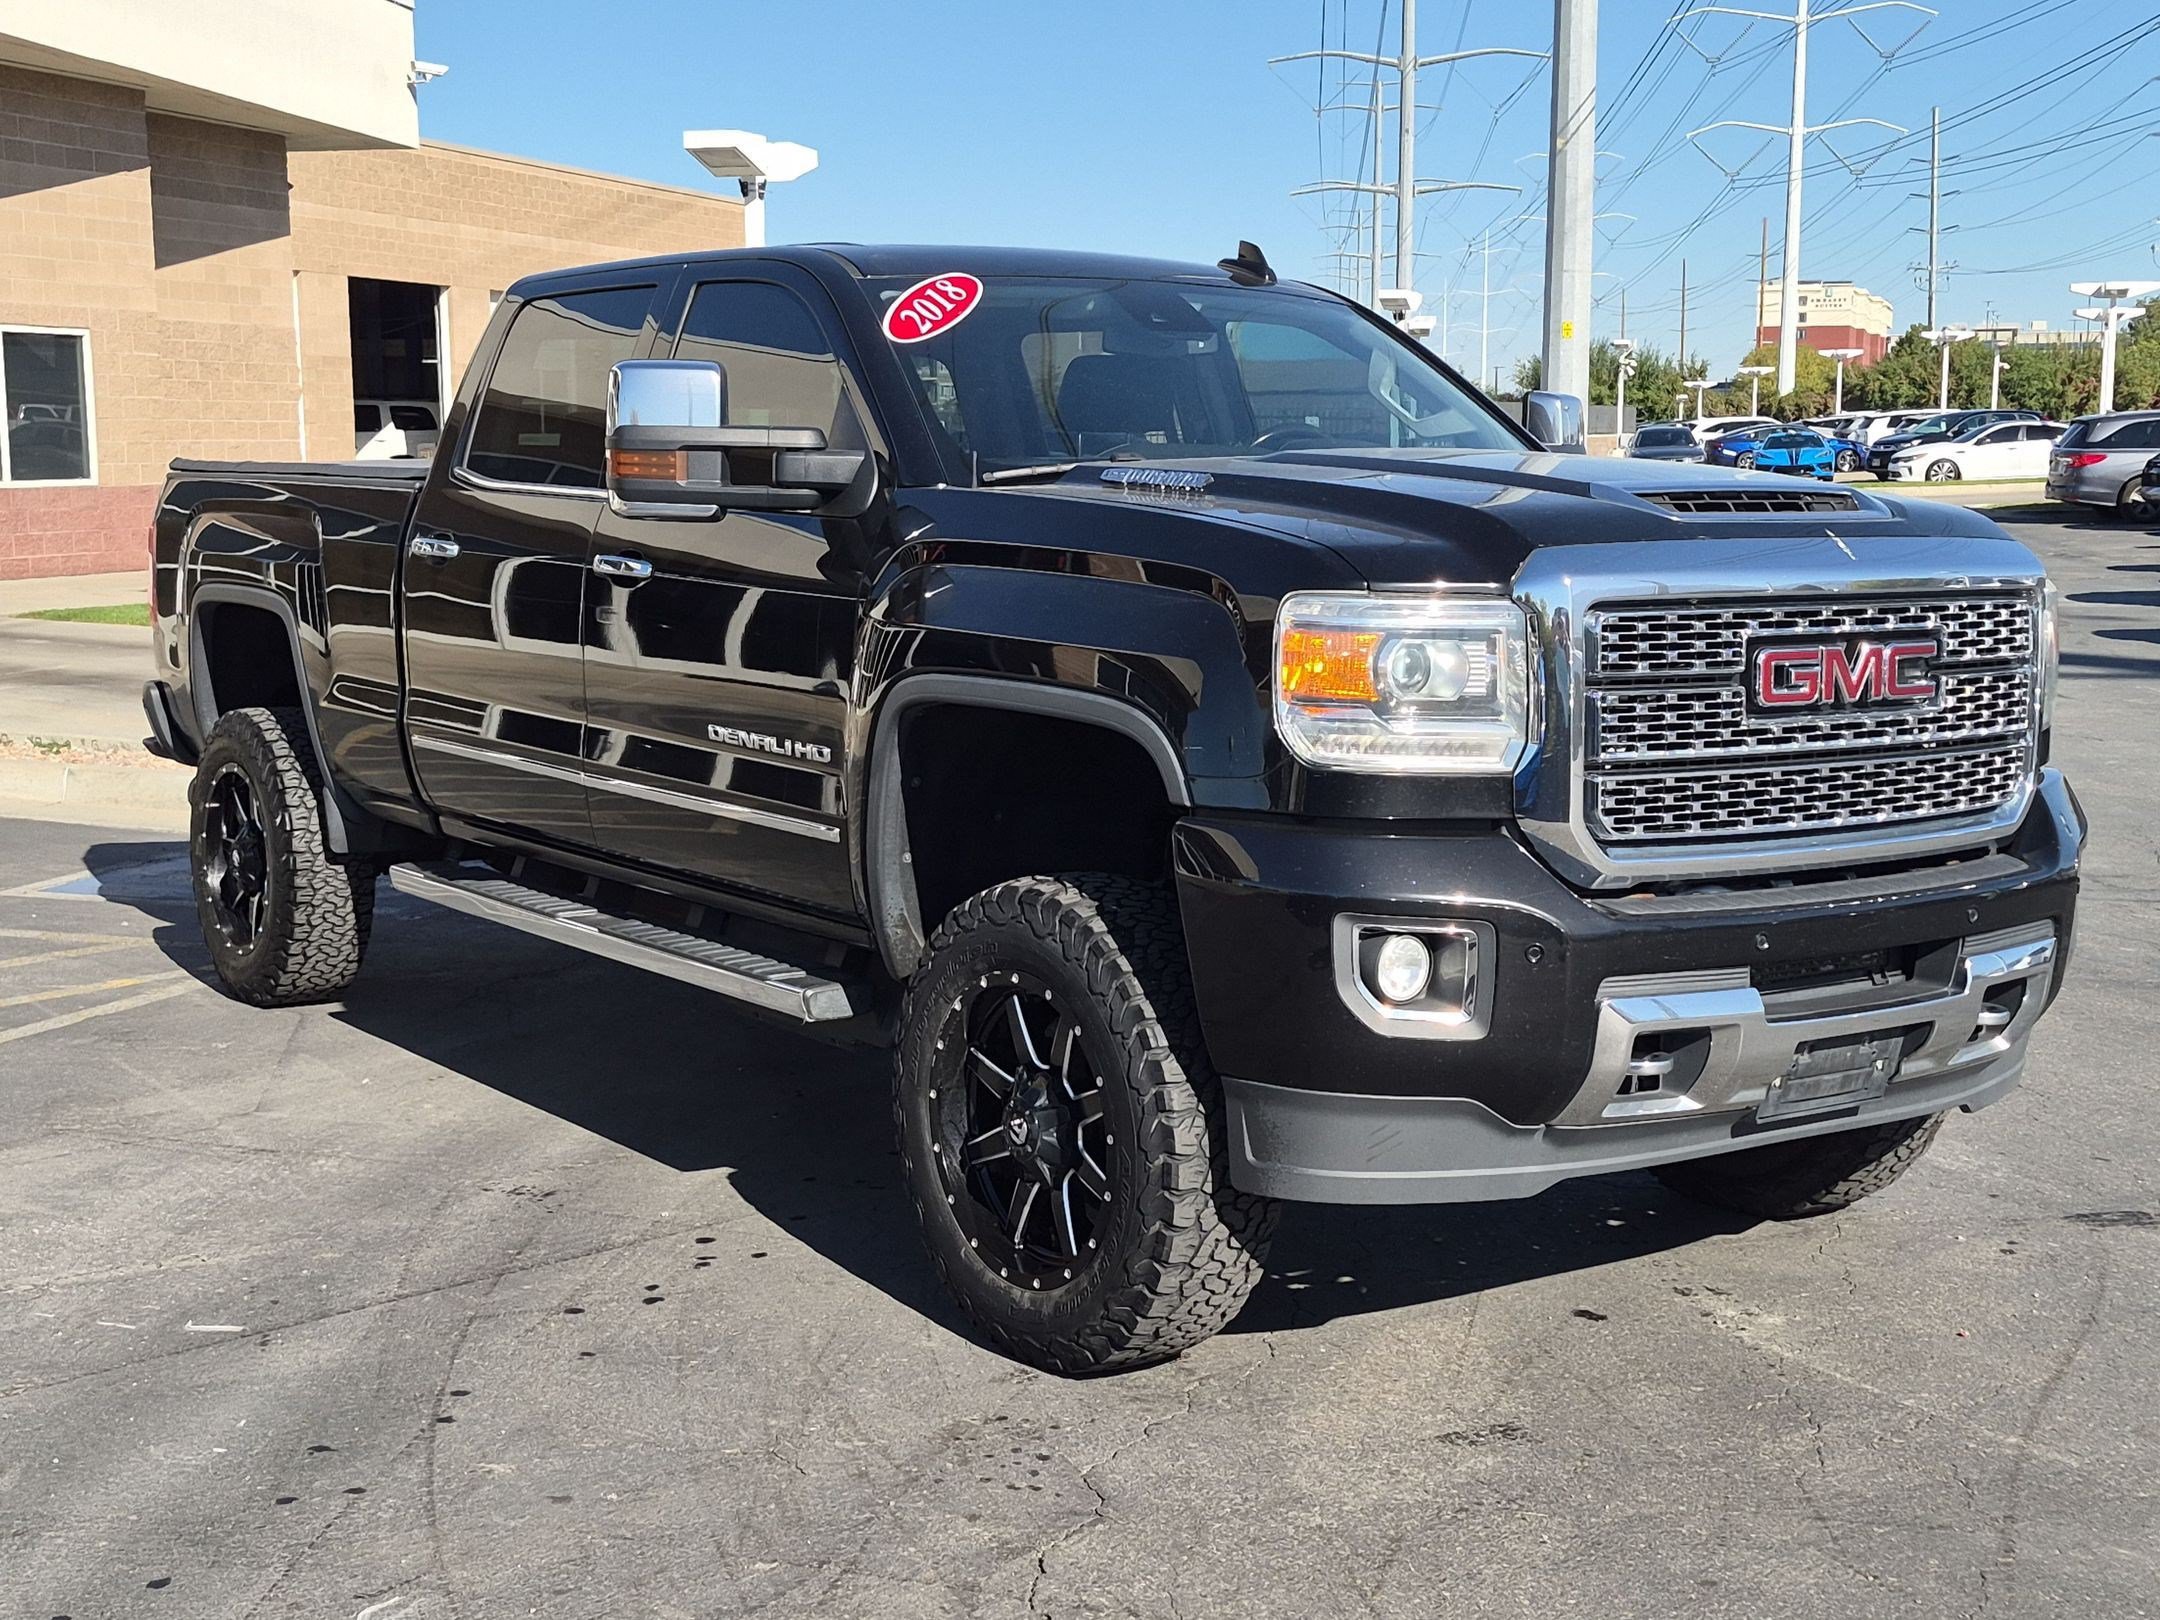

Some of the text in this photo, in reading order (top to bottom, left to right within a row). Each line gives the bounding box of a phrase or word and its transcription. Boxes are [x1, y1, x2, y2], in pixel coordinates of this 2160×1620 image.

[900, 280, 967, 334] 2018
[1757, 641, 1937, 706] GMC
[708, 723, 831, 763] DENALI HD
